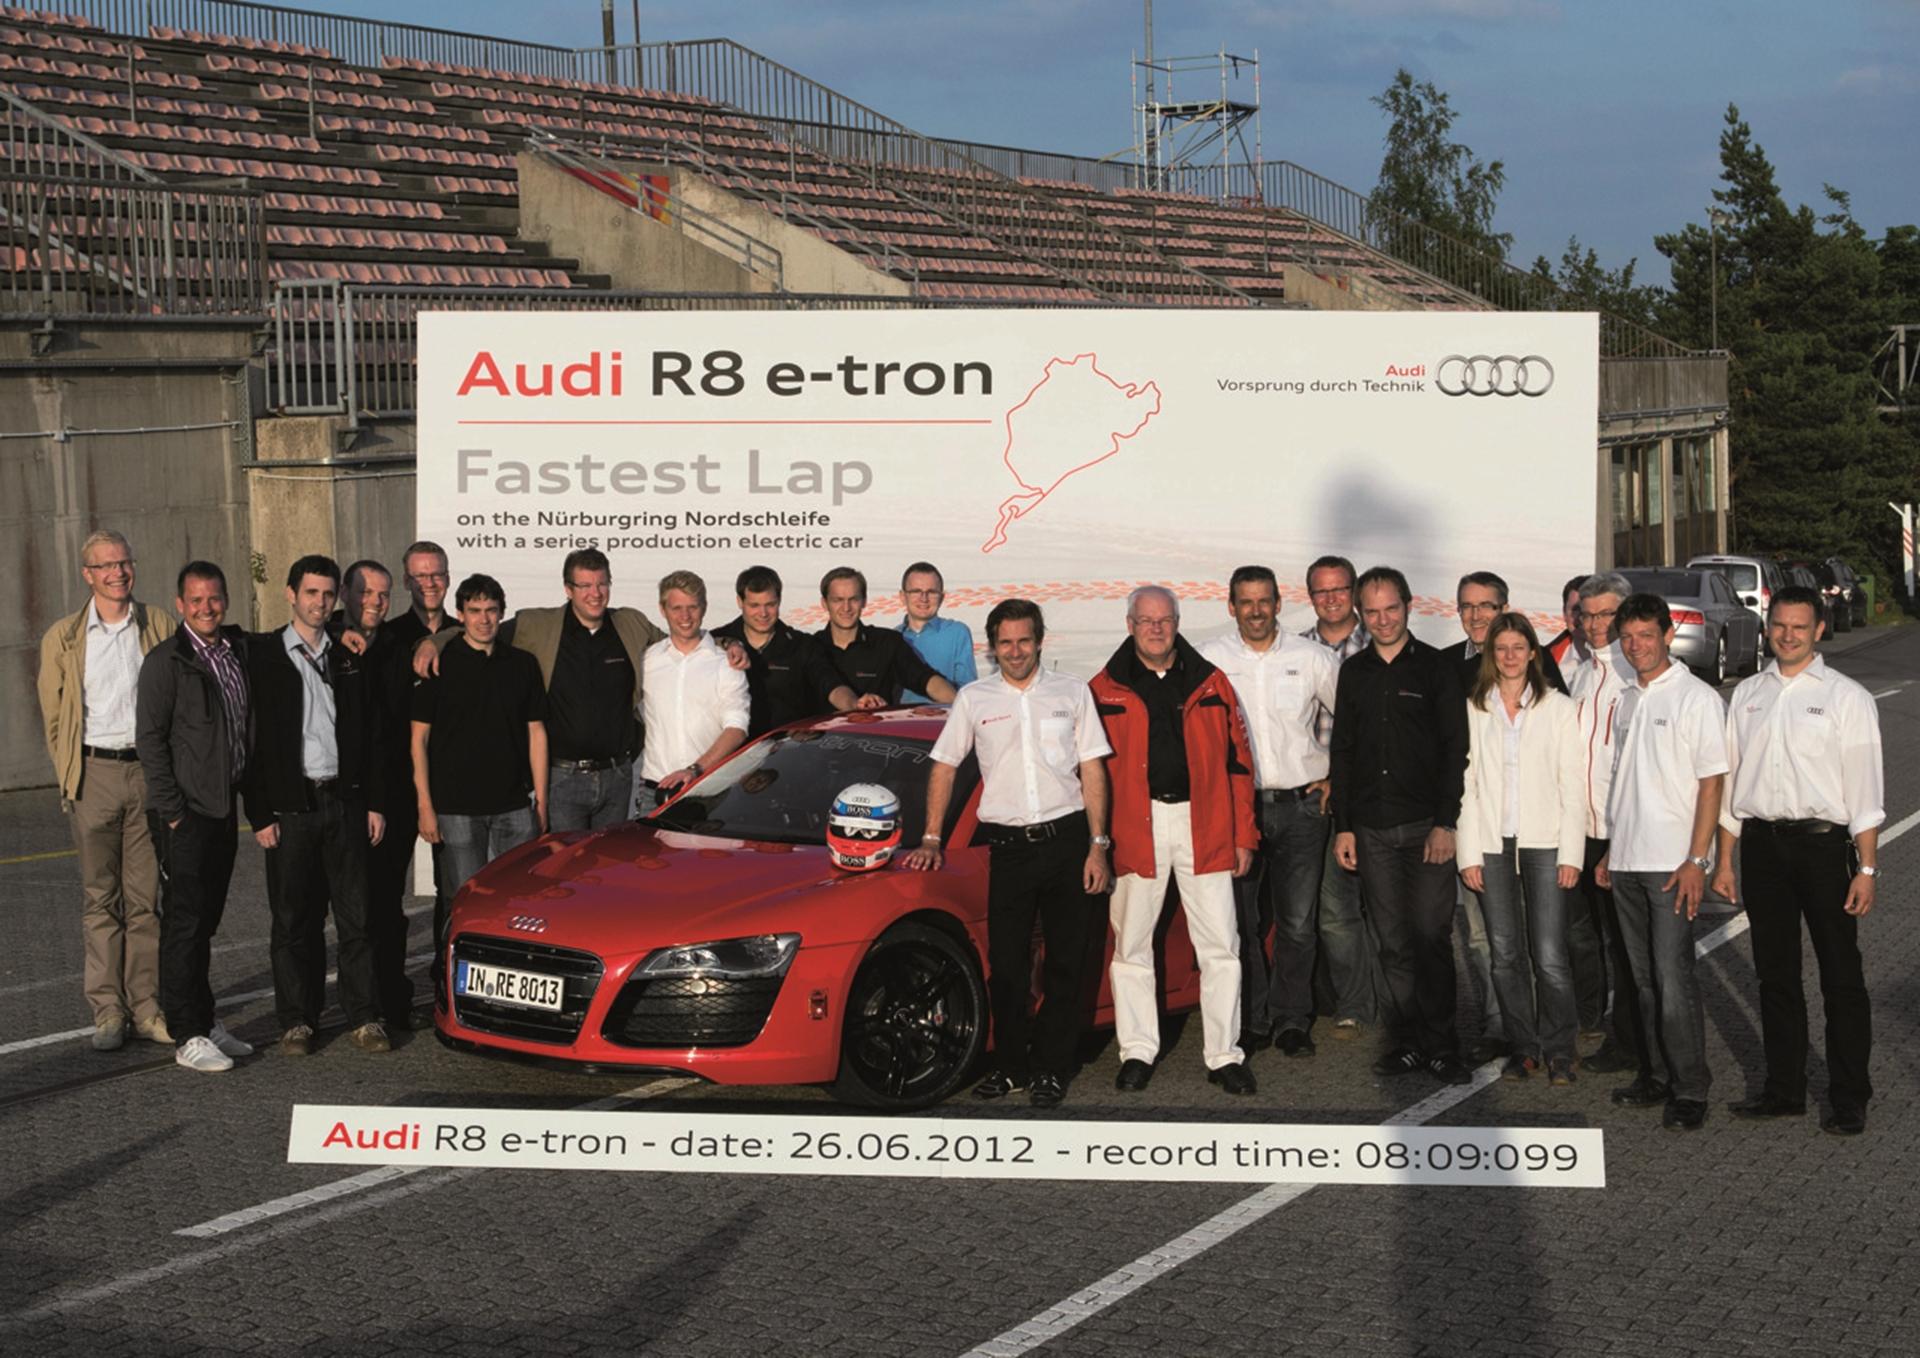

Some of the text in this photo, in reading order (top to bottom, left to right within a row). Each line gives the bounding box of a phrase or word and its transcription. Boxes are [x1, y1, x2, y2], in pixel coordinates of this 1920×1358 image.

[456, 350, 993, 397] Audi R8 e-tron
[1385, 364, 1426, 377] Audi
[1216, 379, 1425, 394] Vorsprung durch Technik
[457, 449, 874, 506] Fastest Lap
[456, 510, 831, 531] on the Nürburgring Nordschleife
[456, 532, 864, 554] with a series production electric car
[847, 805, 871, 816] BOSS
[841, 855, 866, 866] BOSS
[468, 967, 486, 992] IN
[495, 972, 516, 998] RE
[519, 976, 559, 1005] 8013
[321, 1121, 421, 1150] Audi
[434, 1124, 487, 1152] R8
[500, 1130, 627, 1156] e-tron
[670, 1130, 774, 1159] date:
[789, 1131, 1035, 1163] 26.06.2012
[1085, 1139, 1218, 1167] record
[1232, 1139, 1342, 1168] time:
[1356, 1141, 1579, 1172] 08:09:099
